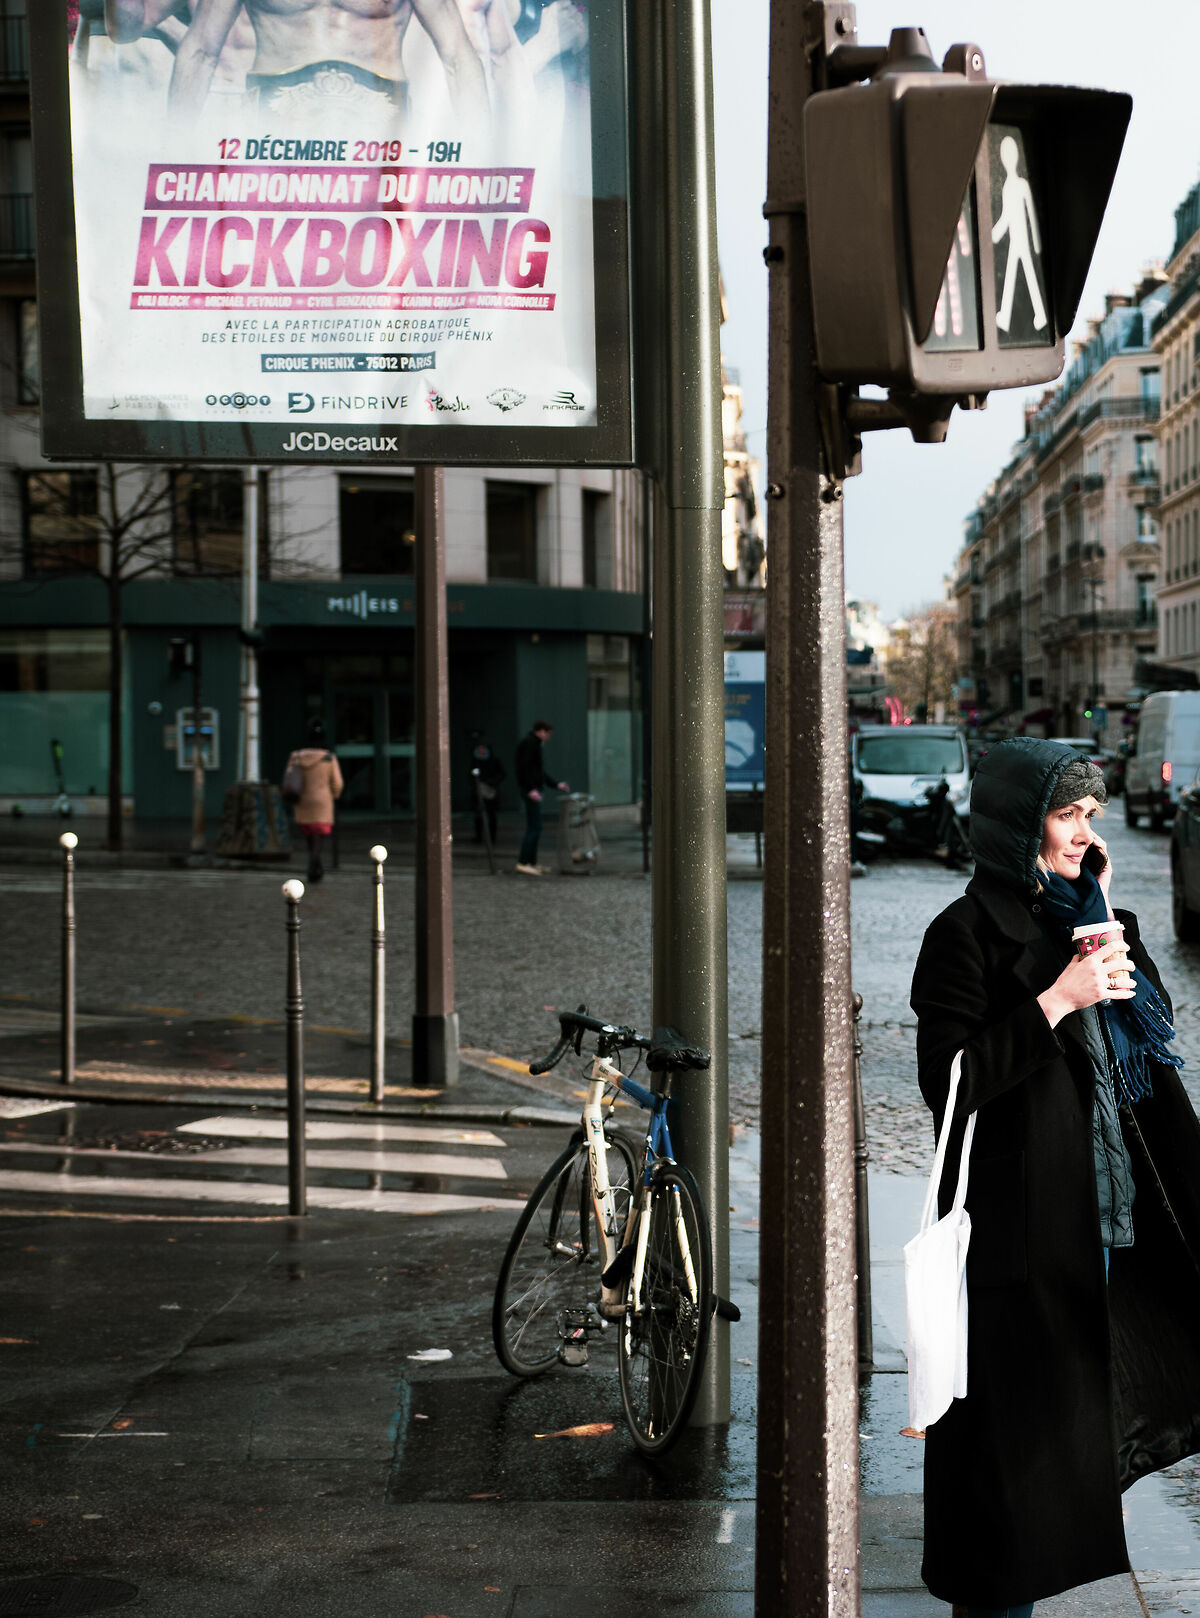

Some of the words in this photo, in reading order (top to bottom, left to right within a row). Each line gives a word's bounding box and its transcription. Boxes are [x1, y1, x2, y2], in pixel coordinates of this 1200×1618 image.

[218, 138, 241, 160] 12
[245, 135, 348, 161] DÉCEMBRE
[352, 140, 402, 162] 2019
[426, 141, 462, 162] 19H
[155, 171, 369, 205] CHAMPIONNAT
[377, 174, 418, 204] DU
[425, 174, 524, 205] MONDE
[133, 216, 551, 289] KICKBOXING
[204, 296, 245, 308] MICHAEL
[247, 296, 292, 308] PEYNAUD
[307, 296, 334, 308] CYRIL
[336, 296, 391, 308] BENZAQUEN
[225, 320, 258, 330] AVEC
[263, 320, 279, 330] LA
[285, 319, 382, 330] PARTICIPATION
[386, 318, 471, 330] ACROBATIQUE
[202, 333, 226, 343] DES
[231, 333, 285, 343] ETOILES
[290, 333, 305, 343] DE
[312, 332, 375, 343] MONGOLIE
[380, 332, 395, 343] DU
[400, 331, 444, 343] CIRQUE
[447, 329, 494, 342] PHÉNIX
[265, 357, 309, 371] CIRQUE
[312, 357, 355, 370] PHENIX
[366, 357, 399, 370] 75012
[400, 355, 433, 370] PARIS
[283, 432, 399, 452] JCDecaux
